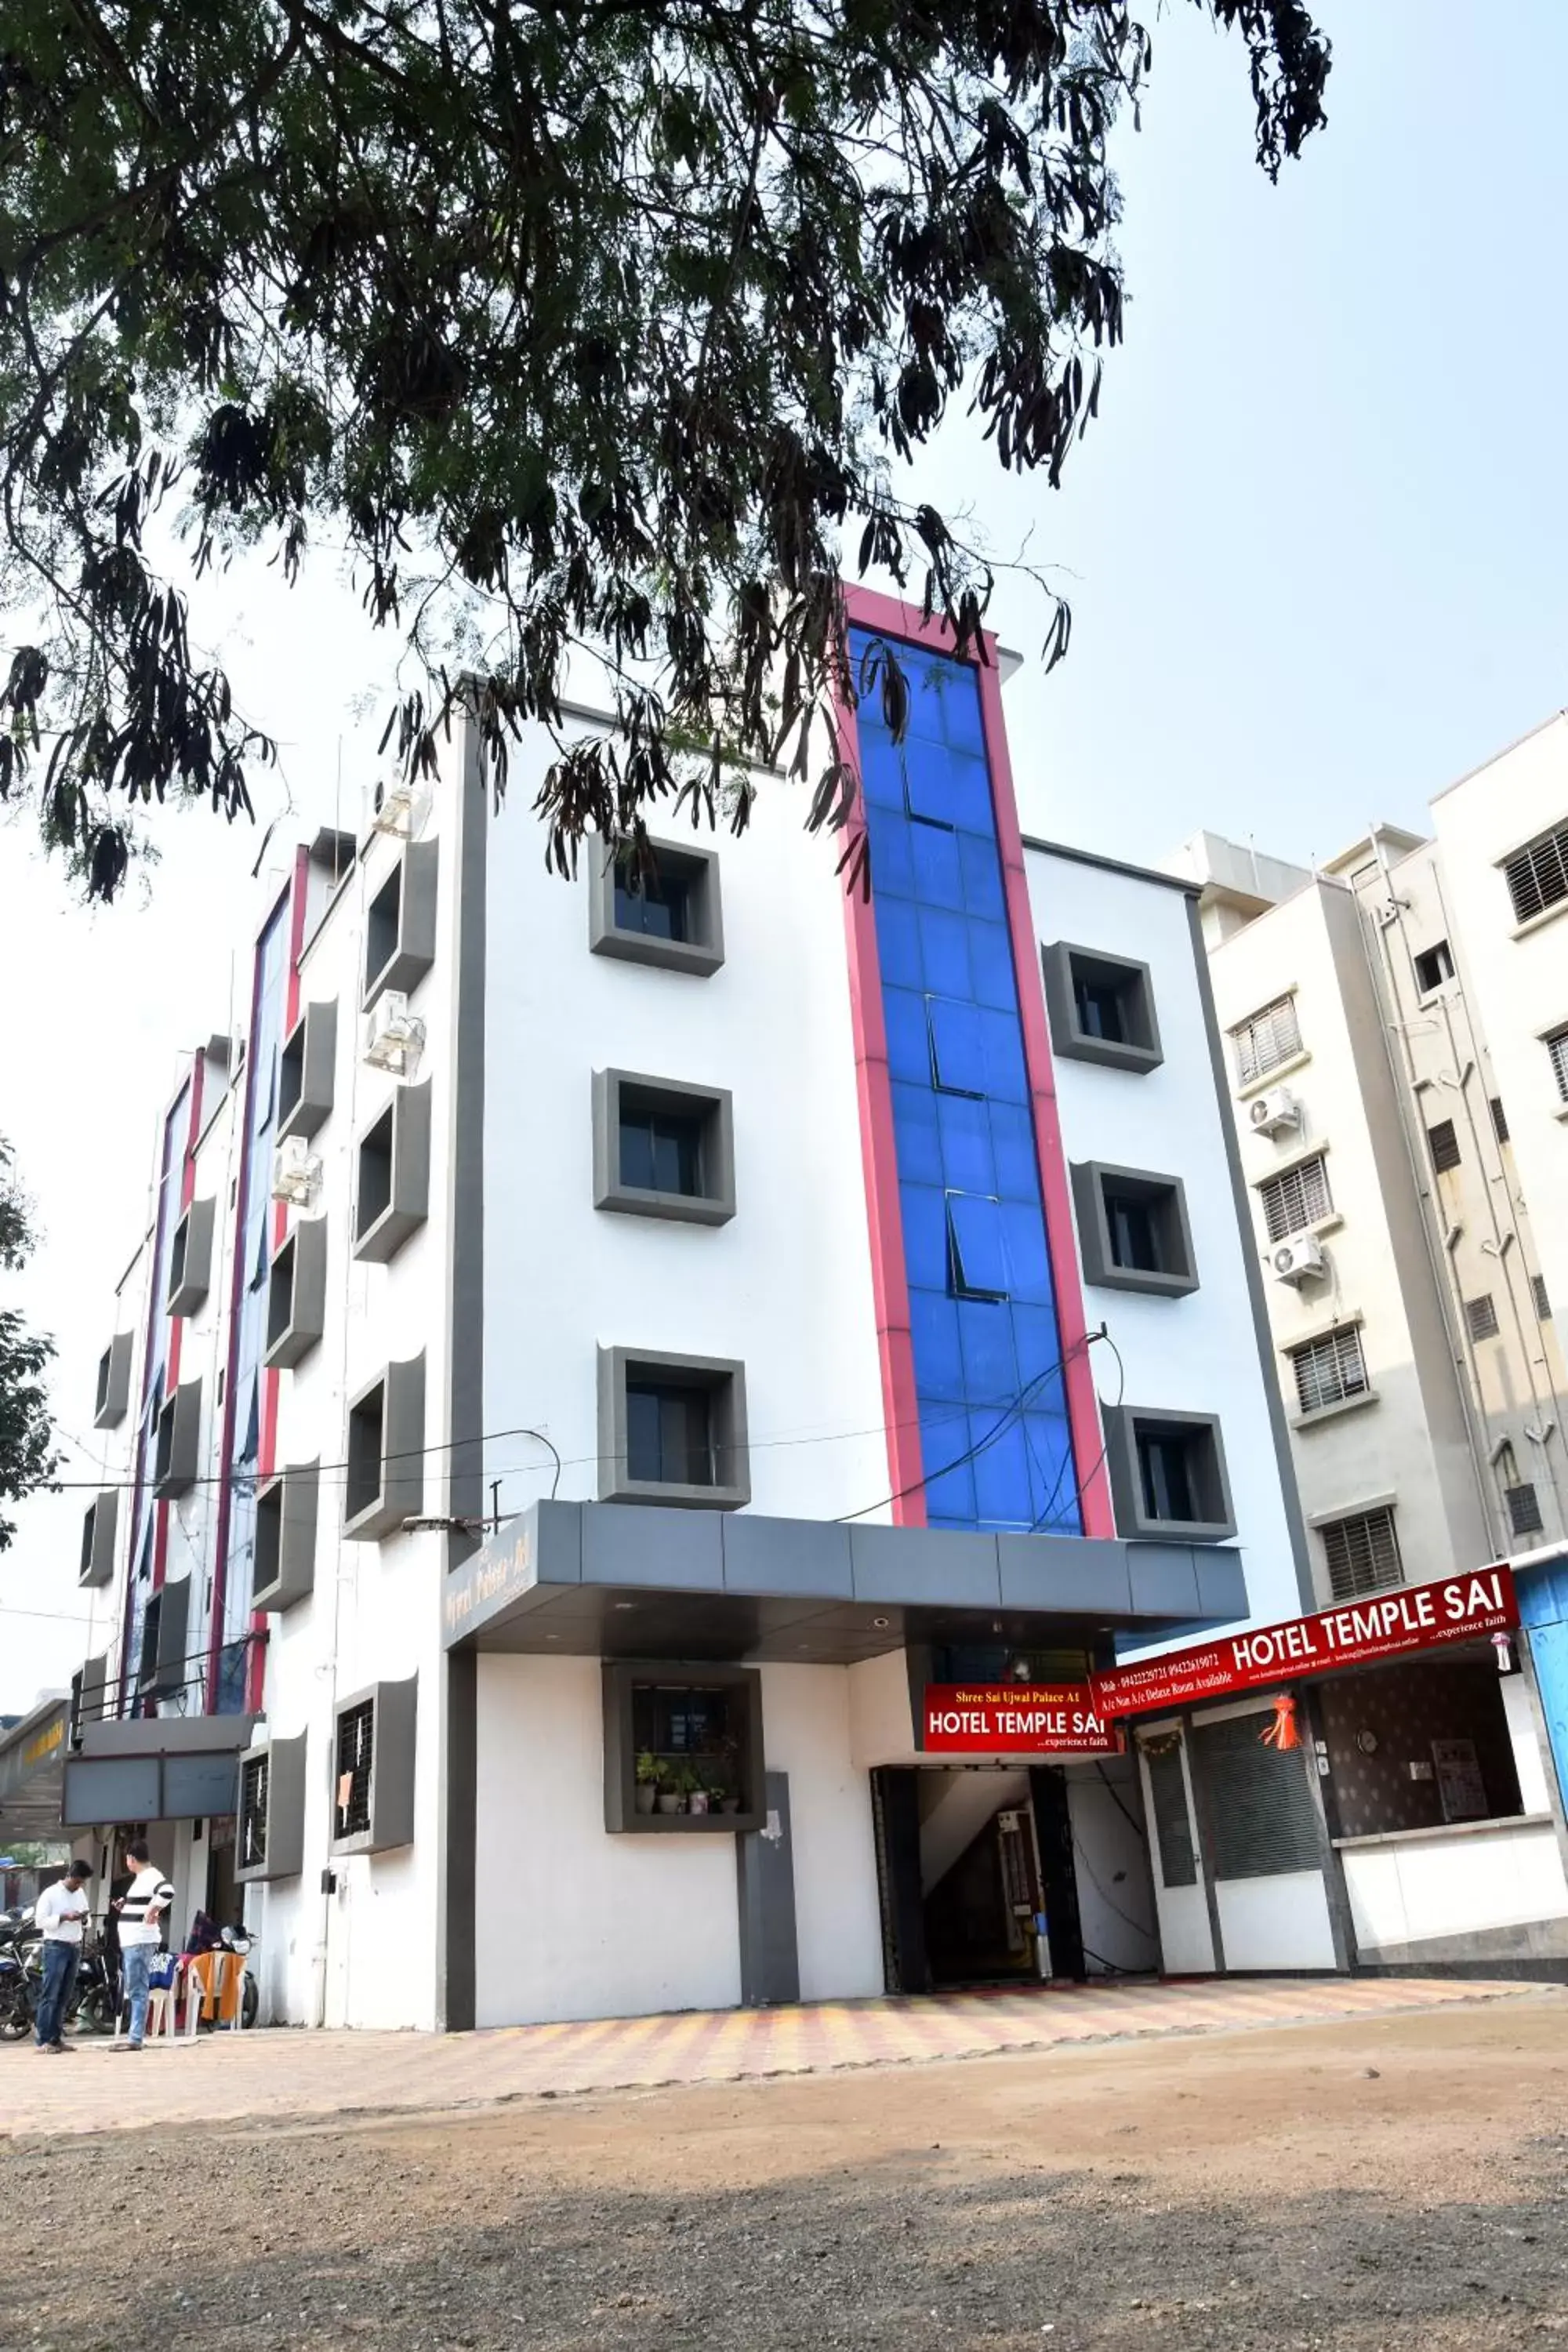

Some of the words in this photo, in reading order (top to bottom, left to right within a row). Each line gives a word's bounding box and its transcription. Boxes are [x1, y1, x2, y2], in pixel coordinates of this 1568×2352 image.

[1232, 1624, 1317, 1671] HOTEL
[1320, 1591, 1436, 1649] TEMPLE
[1443, 1573, 1504, 1620] SAI
[1484, 1614, 1506, 1627] faith
[1145, 1686, 1171, 1701] Deluxe
[1171, 1681, 1195, 1695] Room
[1196, 1670, 1233, 1691] Available
[956, 1692, 984, 1703] Shree
[985, 1692, 1001, 1703] Sai
[1003, 1692, 1030, 1705] Ujwal
[1033, 1692, 1064, 1703] Palace
[928, 1711, 990, 1734] HOTEL
[995, 1711, 1067, 1734] TEMPLE
[1072, 1711, 1105, 1734] SAI
[1089, 1737, 1109, 1747] faith
